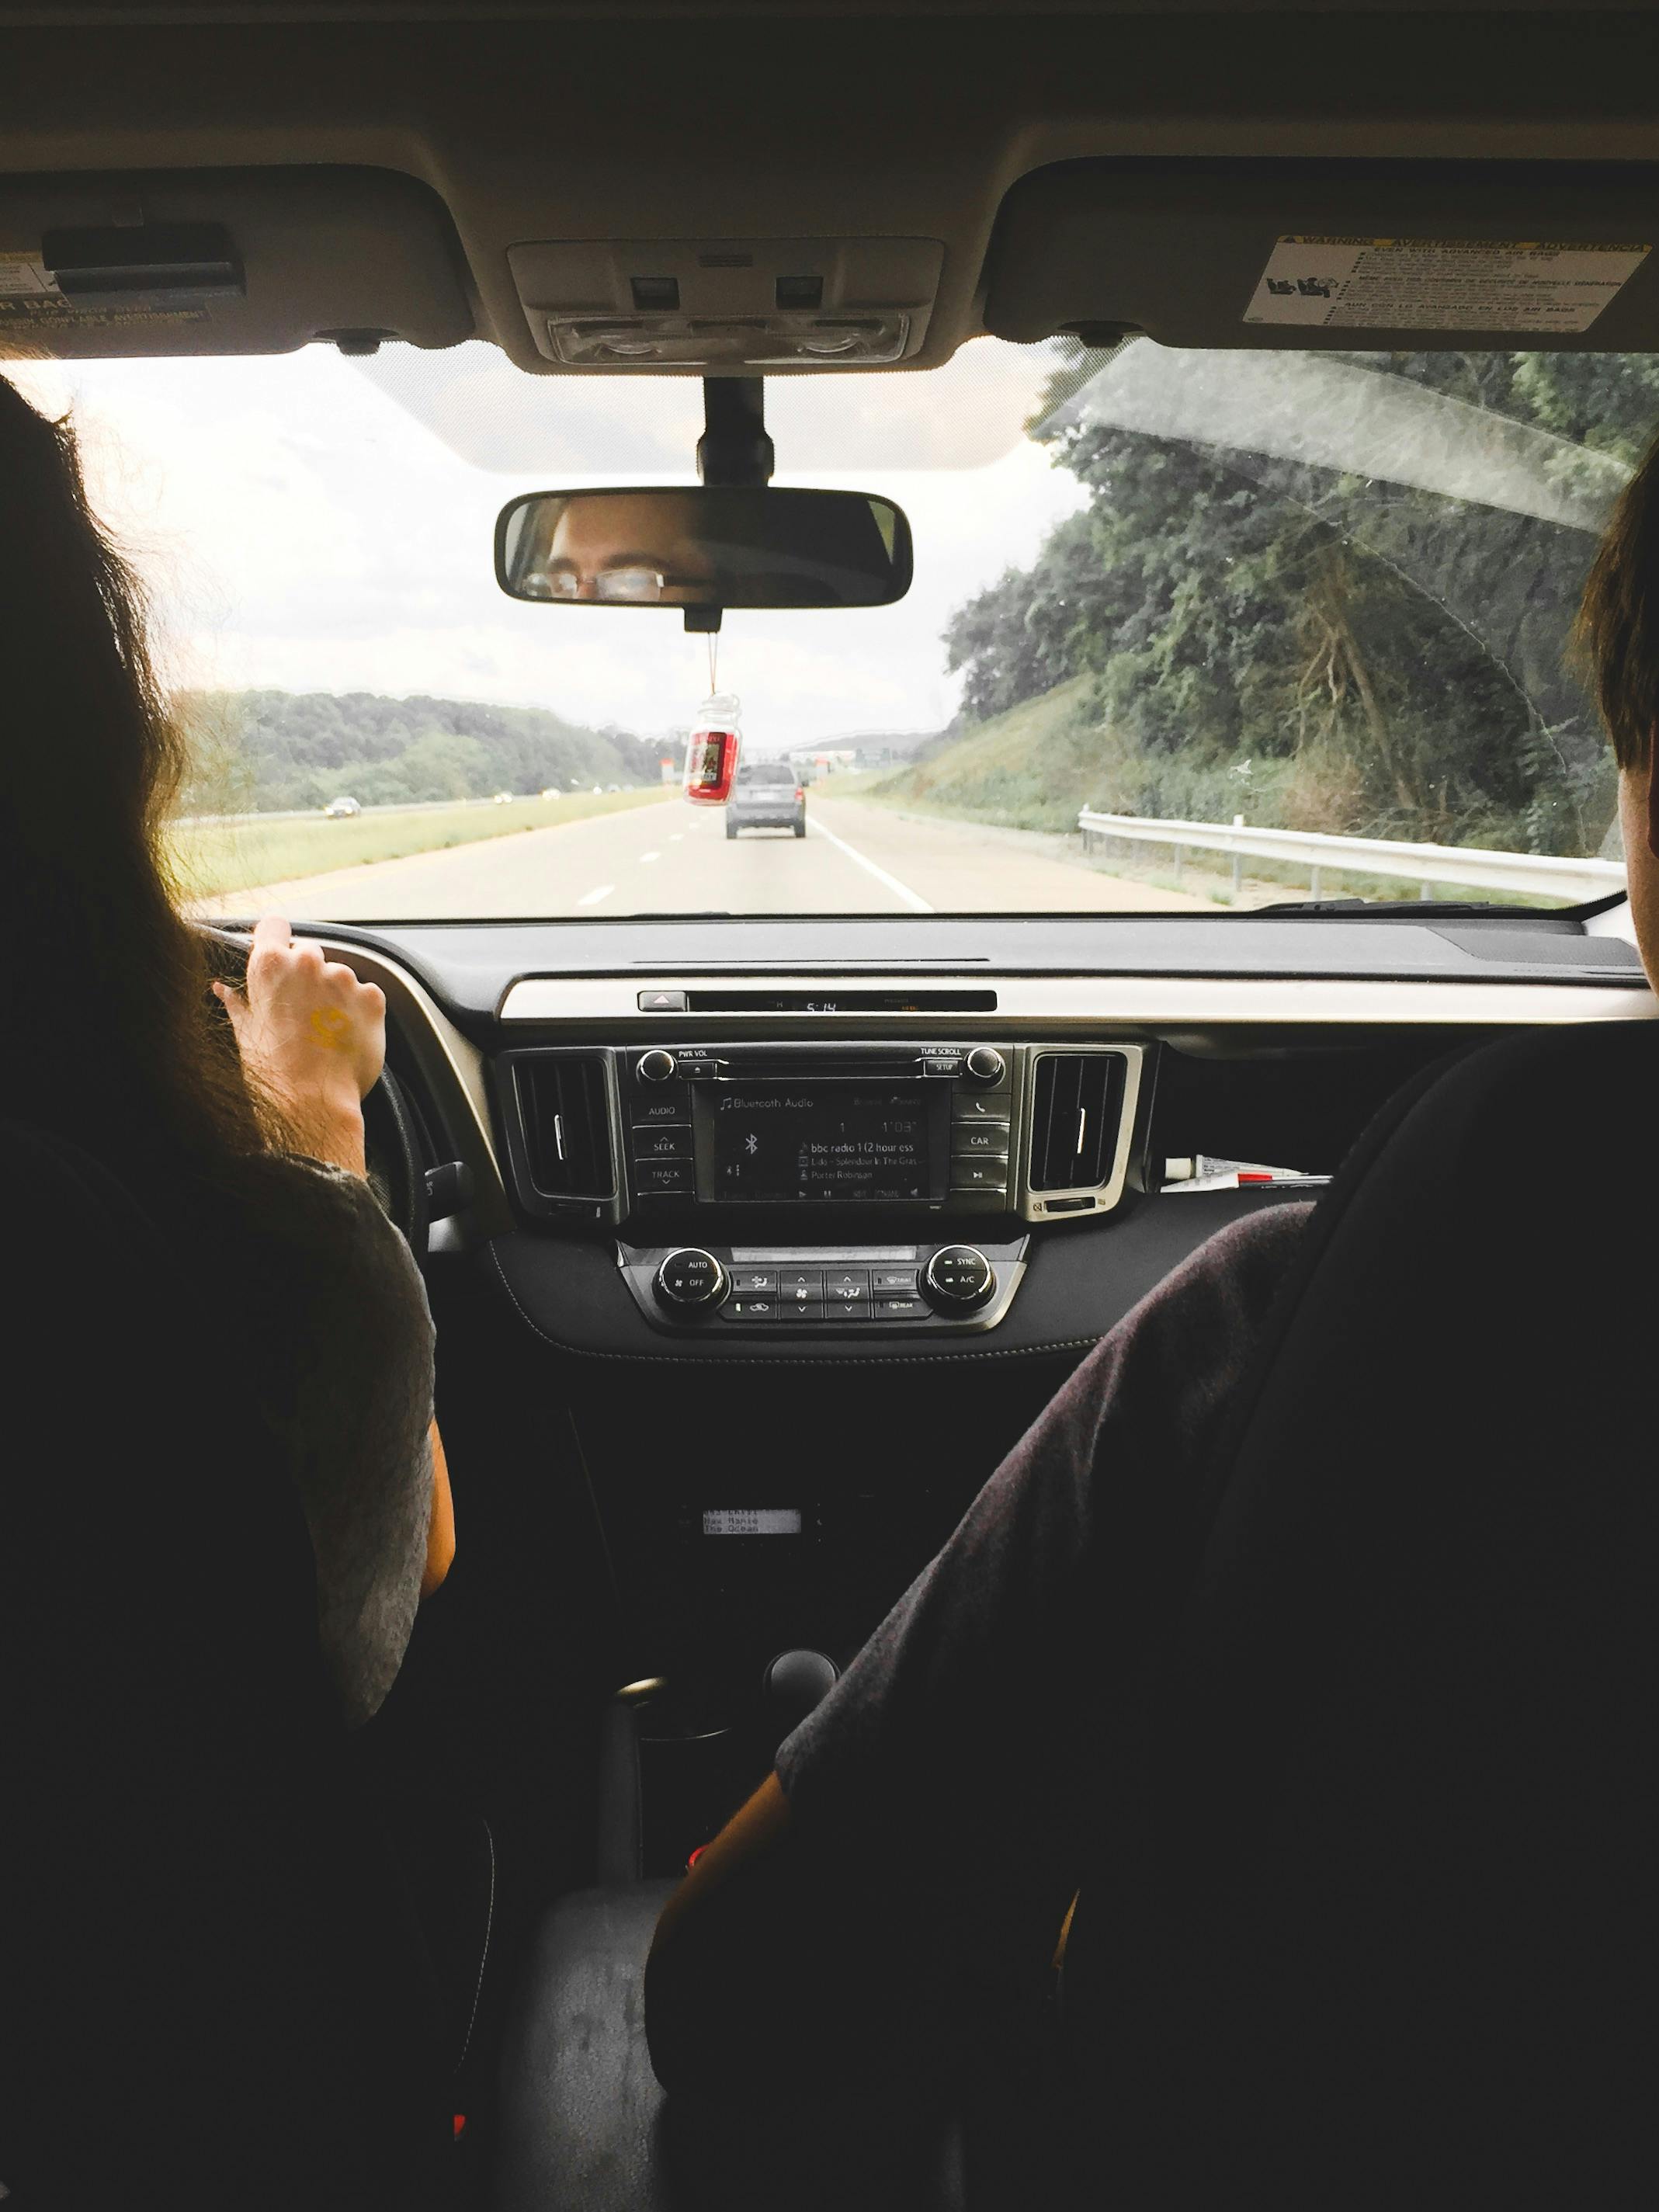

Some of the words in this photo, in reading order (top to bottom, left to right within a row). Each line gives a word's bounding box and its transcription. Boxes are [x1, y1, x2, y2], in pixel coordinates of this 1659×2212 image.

[1303, 236, 1373, 245] WARNING
[1390, 238, 1519, 248] AVERTISSEMENT
[1534, 242, 1645, 252] ADVERTENCIA
[734, 1098, 780, 1108] Bluetooth
[785, 1098, 814, 1107] Audio
[971, 1137, 989, 1145] CAR
[811, 1143, 828, 1153] bbc
[831, 1143, 855, 1153] radio
[876, 1143, 897, 1152] hour
[899, 1144, 914, 1153] ess
[883, 1157, 897, 1165] The
[652, 1170, 680, 1179] TRACK
